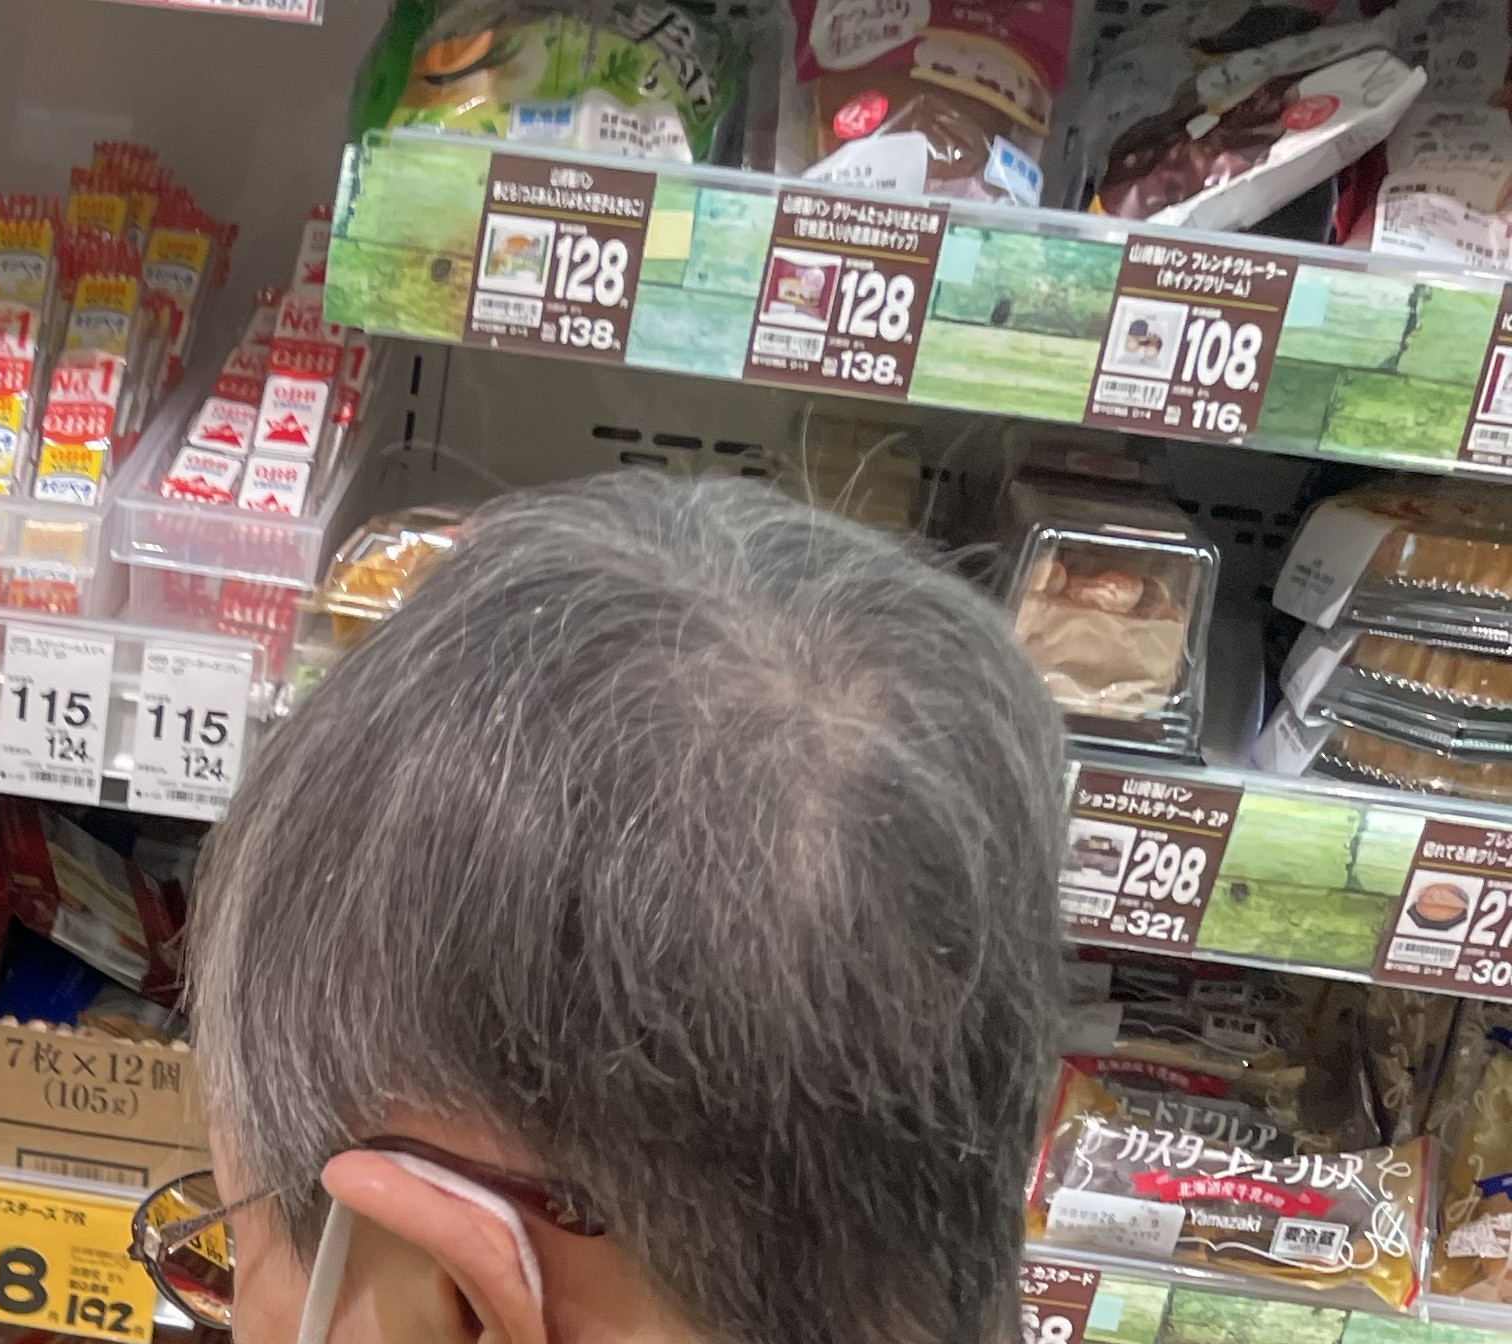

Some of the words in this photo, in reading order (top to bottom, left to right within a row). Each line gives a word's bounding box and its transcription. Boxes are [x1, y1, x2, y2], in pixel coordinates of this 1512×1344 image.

[9, 684, 91, 727] 115
[146, 703, 231, 746] 115
[1190, 1207, 1264, 1234] Yamazaki
